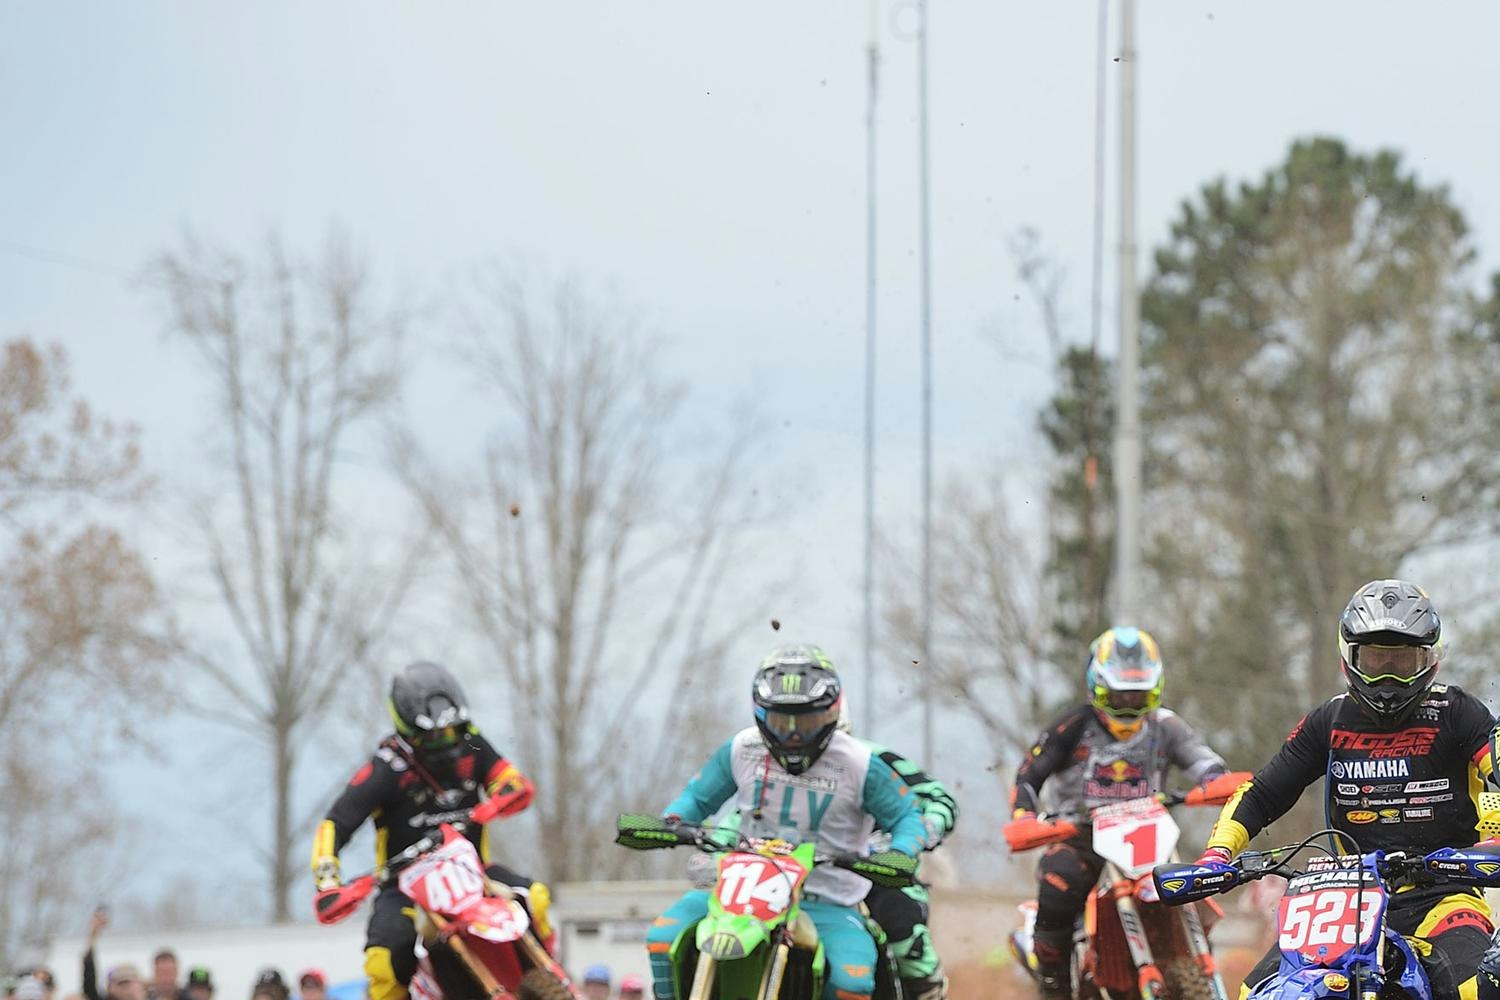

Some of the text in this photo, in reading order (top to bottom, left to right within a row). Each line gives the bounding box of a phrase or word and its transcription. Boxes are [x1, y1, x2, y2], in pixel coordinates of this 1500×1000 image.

[1330, 727, 1441, 750] MOOSE
[1369, 745, 1432, 759] RACING
[1343, 759, 1410, 779] YAMAHA
[752, 779, 835, 832] FLY
[1123, 823, 1157, 867] 1
[424, 853, 482, 912] 410
[719, 862, 800, 913] 114
[1289, 871, 1375, 889] MICHAEL
[1279, 891, 1383, 951] 523
